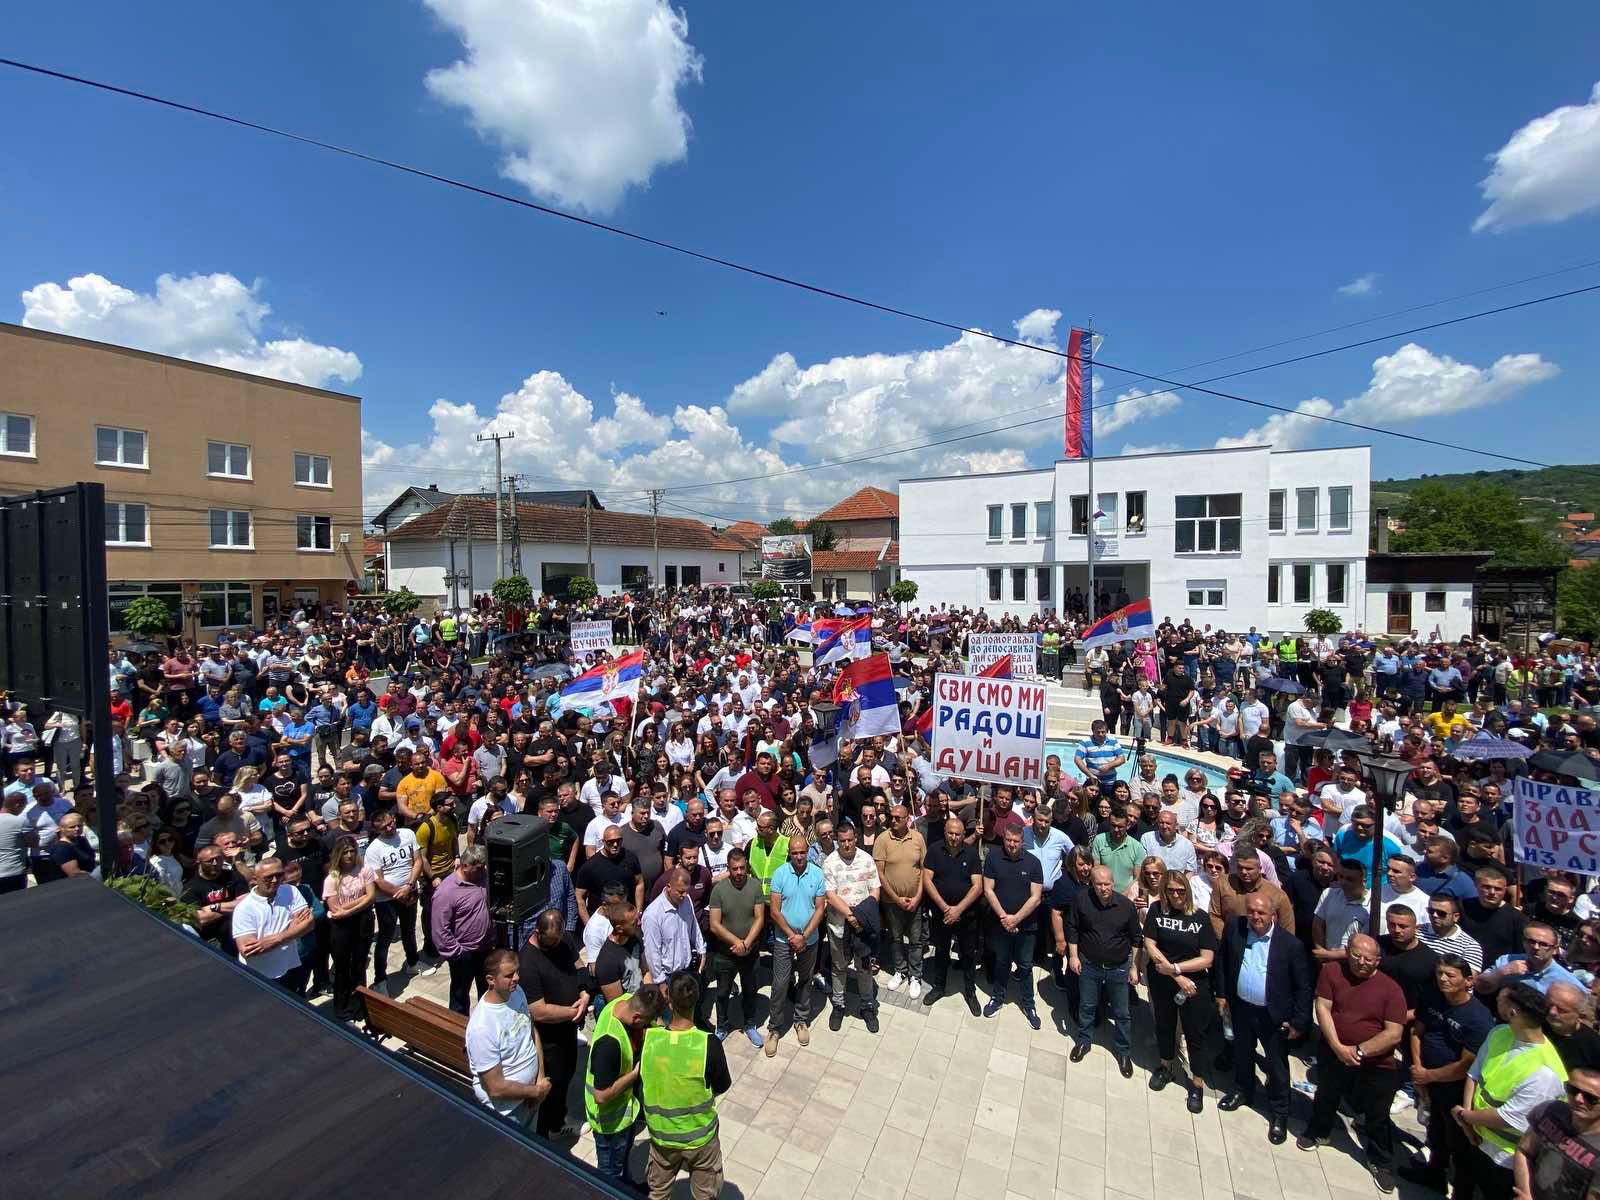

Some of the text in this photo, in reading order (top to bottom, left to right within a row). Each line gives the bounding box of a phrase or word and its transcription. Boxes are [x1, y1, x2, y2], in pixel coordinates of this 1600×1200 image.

[573, 638, 610, 649] ВУЧИЋУ
[970, 644, 1034, 654] ДО ЛЕПОСАВИЋА
[939, 678, 1045, 712] СВИ СМО МИ
[939, 705, 1041, 739] РАДОШ
[936, 747, 1040, 780] ДУШАН
[1521, 780, 1600, 806] ПРАВ
[1525, 800, 1600, 831] ЗЛА
[1155, 917, 1203, 934] REPLAY
